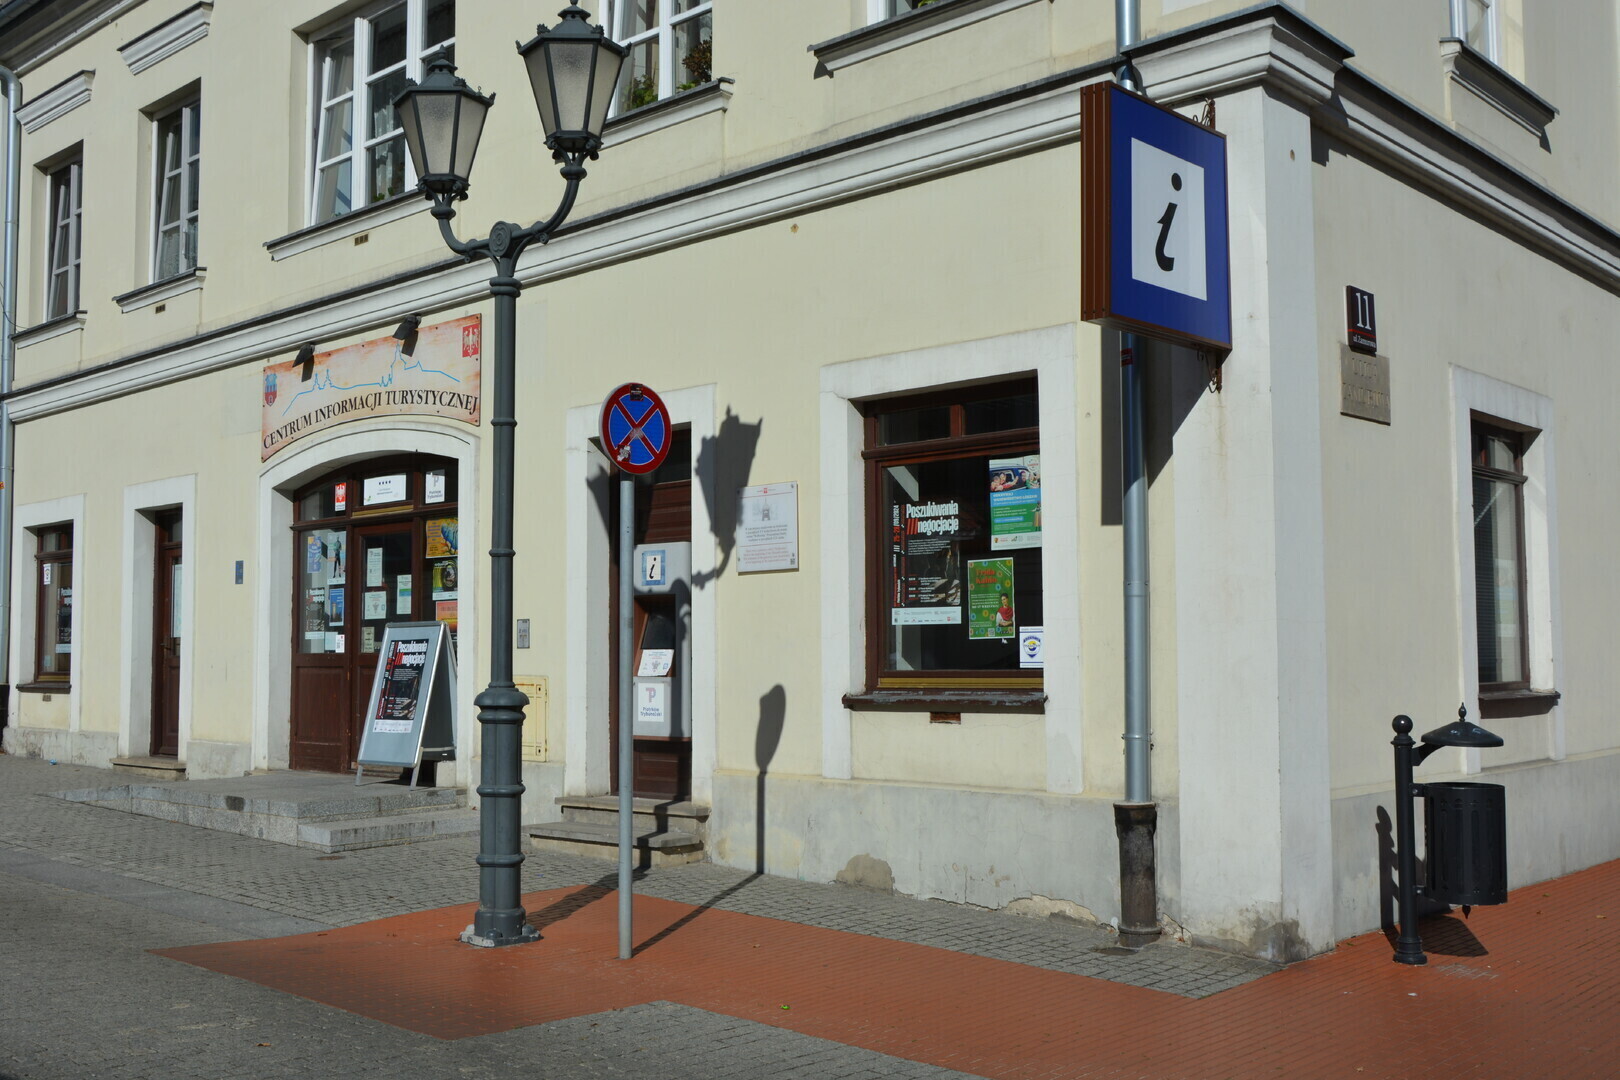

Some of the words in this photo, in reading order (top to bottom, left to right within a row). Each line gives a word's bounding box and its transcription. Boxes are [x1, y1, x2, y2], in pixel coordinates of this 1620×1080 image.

[1355, 292, 1372, 331] 11
[263, 413, 312, 450] CENTRUM
[315, 391, 382, 423] INFORMACJI
[385, 389, 478, 415] TURYSTYCZNEJ
[906, 500, 959, 518] Poszukiwania
